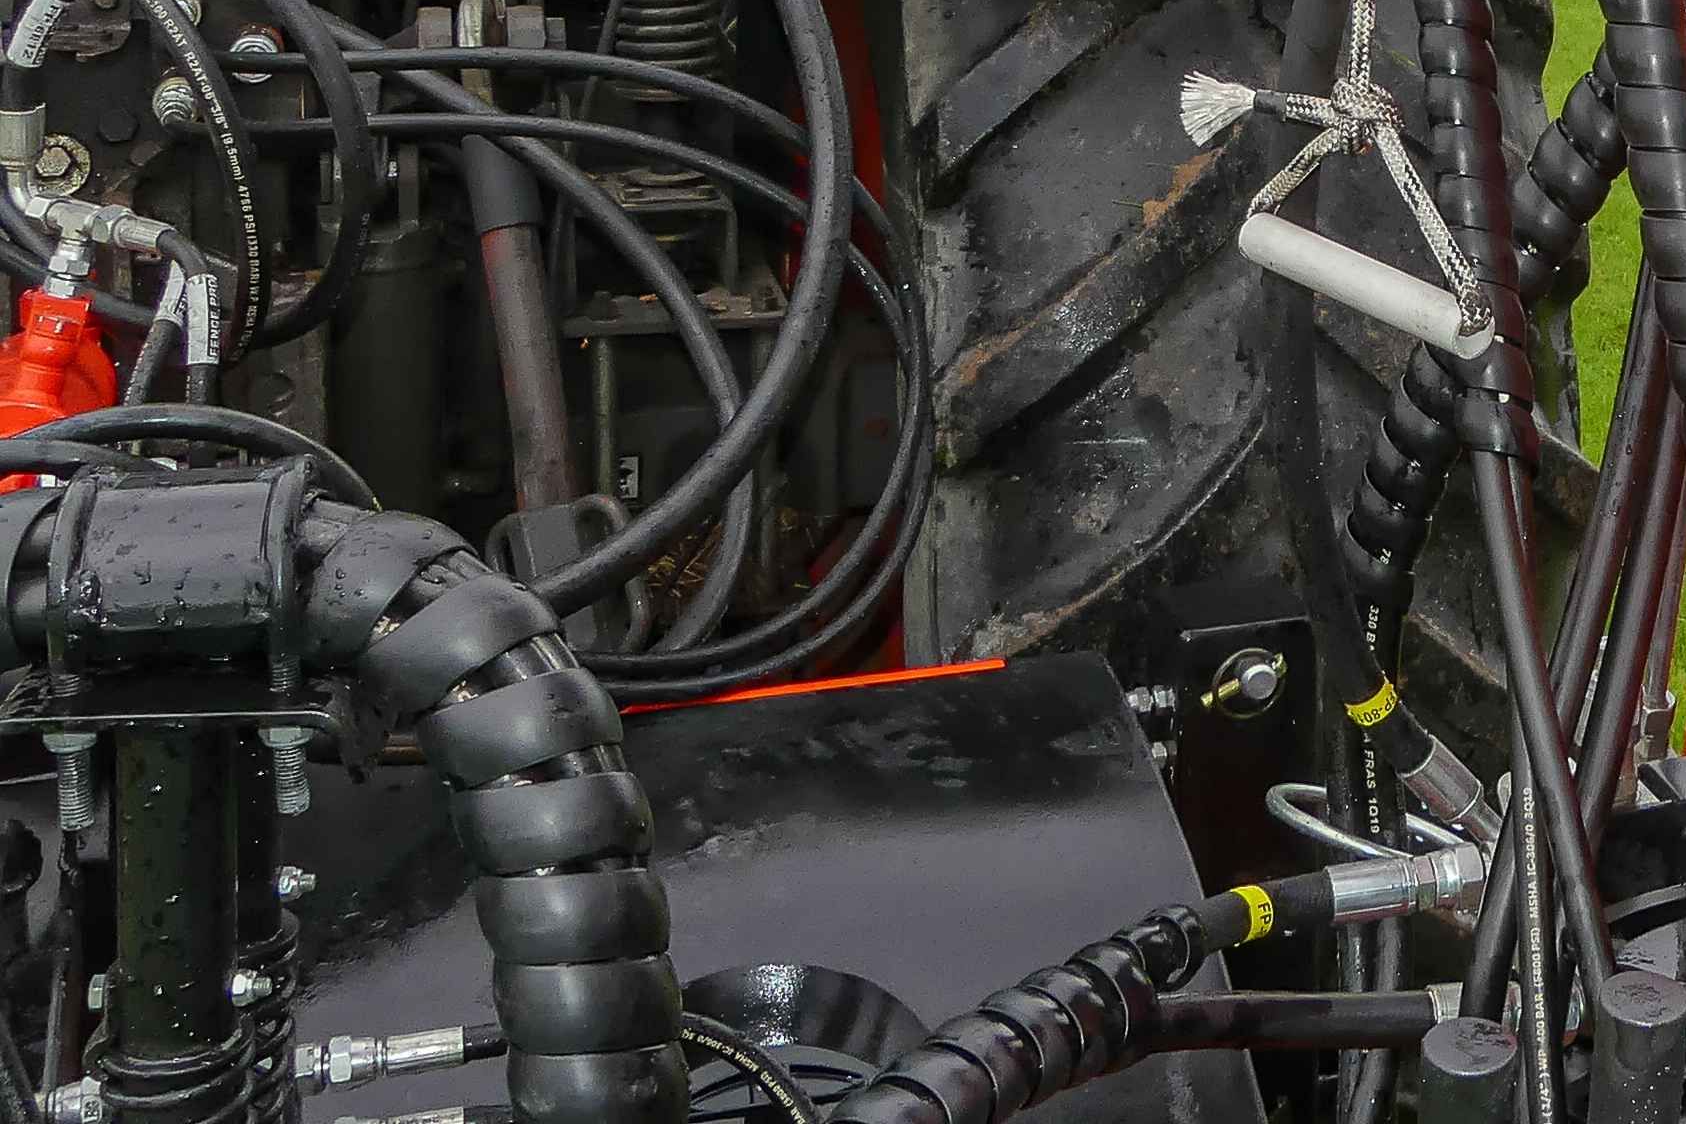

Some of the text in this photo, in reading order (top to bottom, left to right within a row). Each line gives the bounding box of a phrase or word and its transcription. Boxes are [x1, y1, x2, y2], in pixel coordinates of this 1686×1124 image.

[1364, 749, 1377, 789] FRAS
[1523, 787, 1535, 819] 3Q19
[1528, 880, 1539, 918] MSHA
[1535, 993, 1545, 1019] BAR
